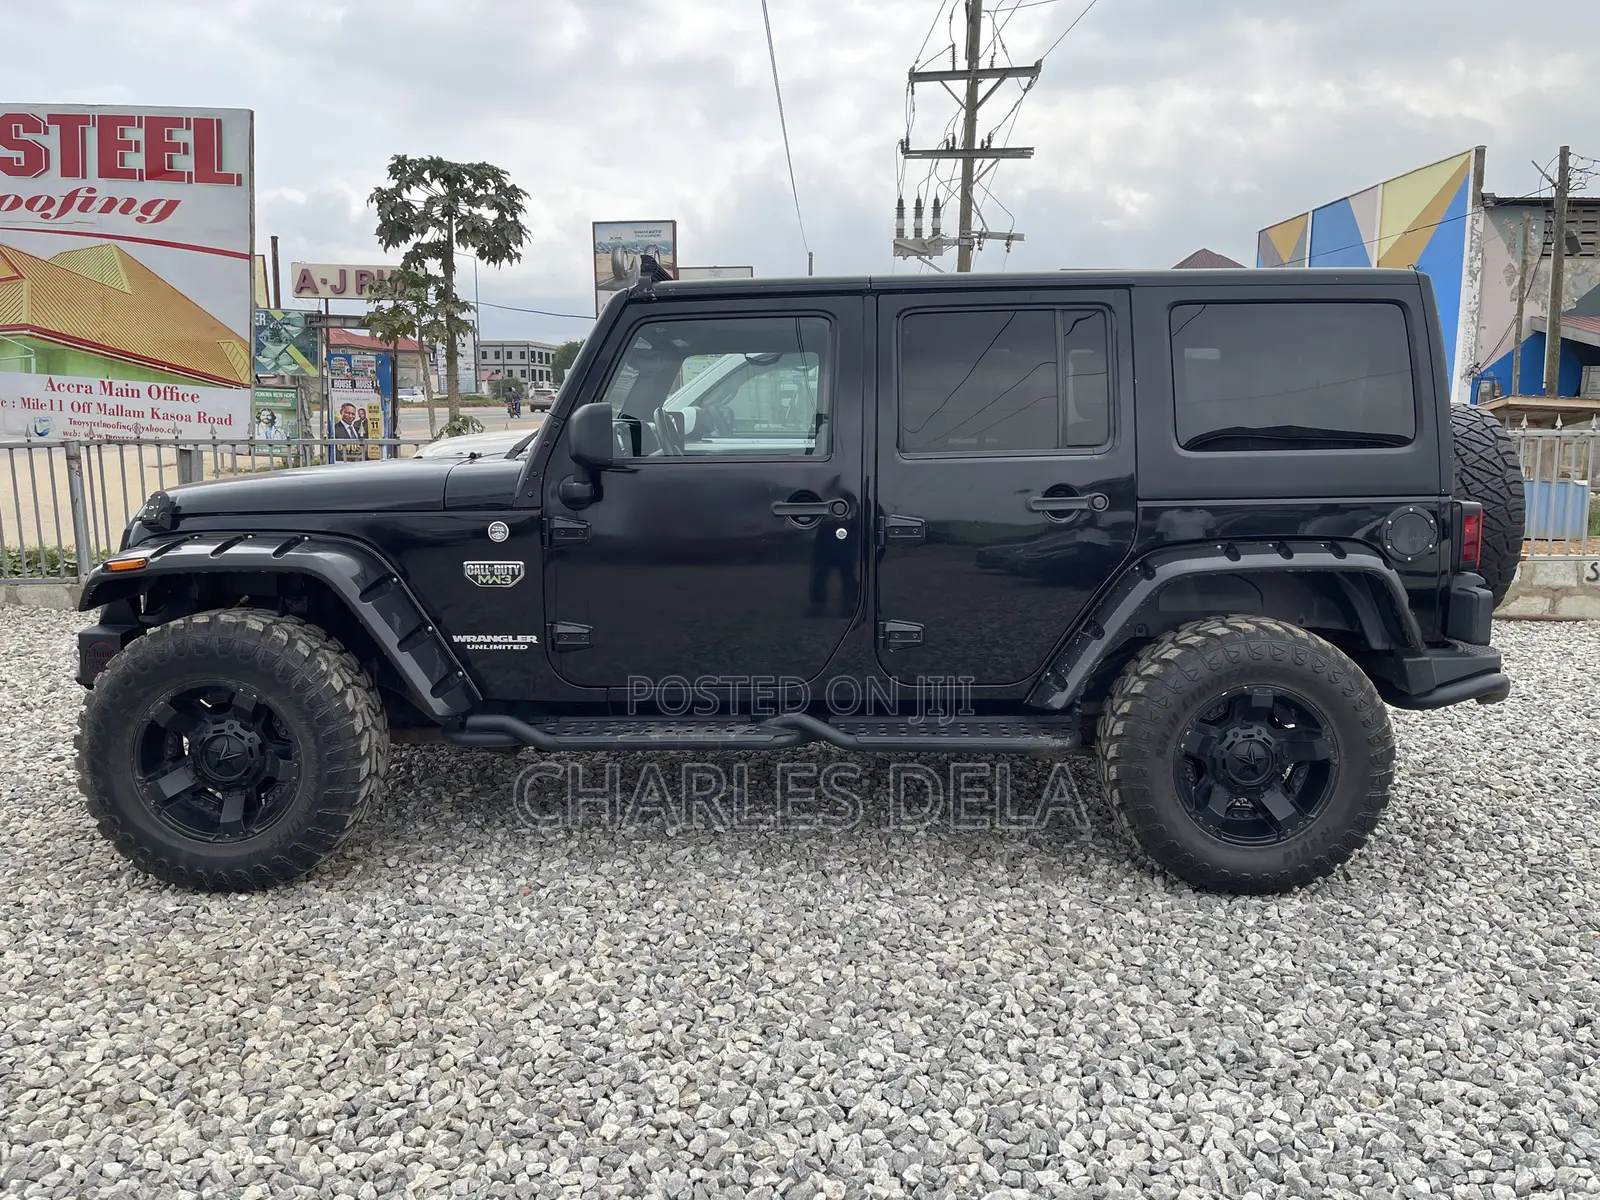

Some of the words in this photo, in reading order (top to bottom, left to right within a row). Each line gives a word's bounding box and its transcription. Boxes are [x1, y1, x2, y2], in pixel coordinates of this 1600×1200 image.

[0, 113, 243, 186] STEEL
[44, 376, 94, 394] Accra
[98, 380, 141, 399] Main
[147, 384, 200, 404] Office
[70, 400, 93, 414] Off
[96, 402, 145, 419] Mallam
[150, 407, 192, 423] Kasoa
[197, 411, 232, 426] Road
[467, 564, 490, 575] CALL
[493, 564, 520, 575] DUTY
[478, 575, 512, 585] MW3
[452, 635, 538, 644] WRANGLER
